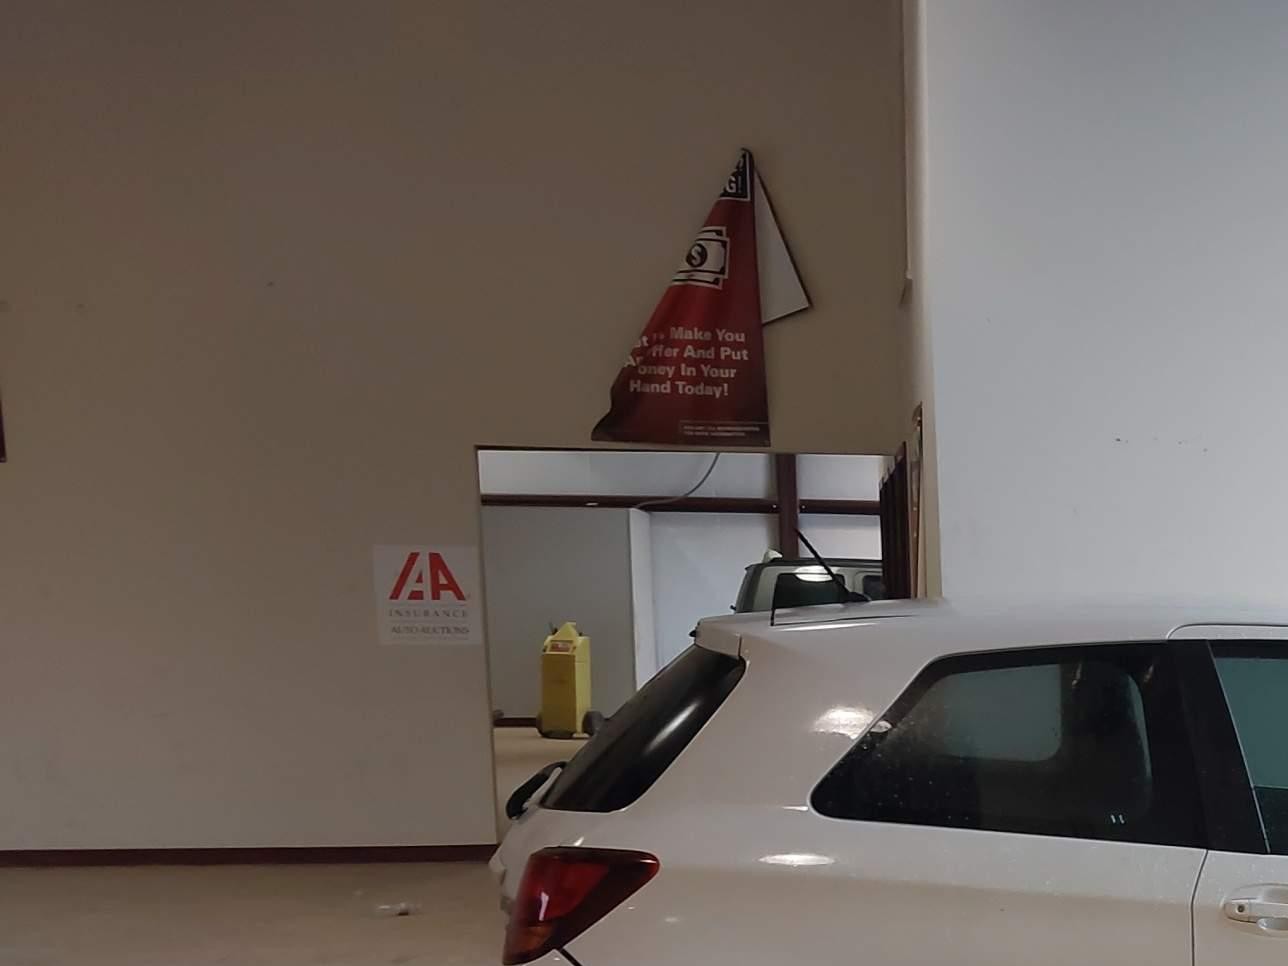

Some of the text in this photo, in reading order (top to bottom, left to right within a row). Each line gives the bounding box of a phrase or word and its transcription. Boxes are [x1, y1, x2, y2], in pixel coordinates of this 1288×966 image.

[670, 327, 711, 341] Make
[716, 329, 745, 342] You
[651, 345, 679, 358] ffer
[683, 345, 714, 359] And
[720, 346, 749, 361] Put
[638, 363, 736, 378] oney In Your
[629, 379, 729, 398] Hand Today!
[388, 609, 468, 617] INSURANCE
[391, 625, 470, 634] AUTO AUCTIONS
